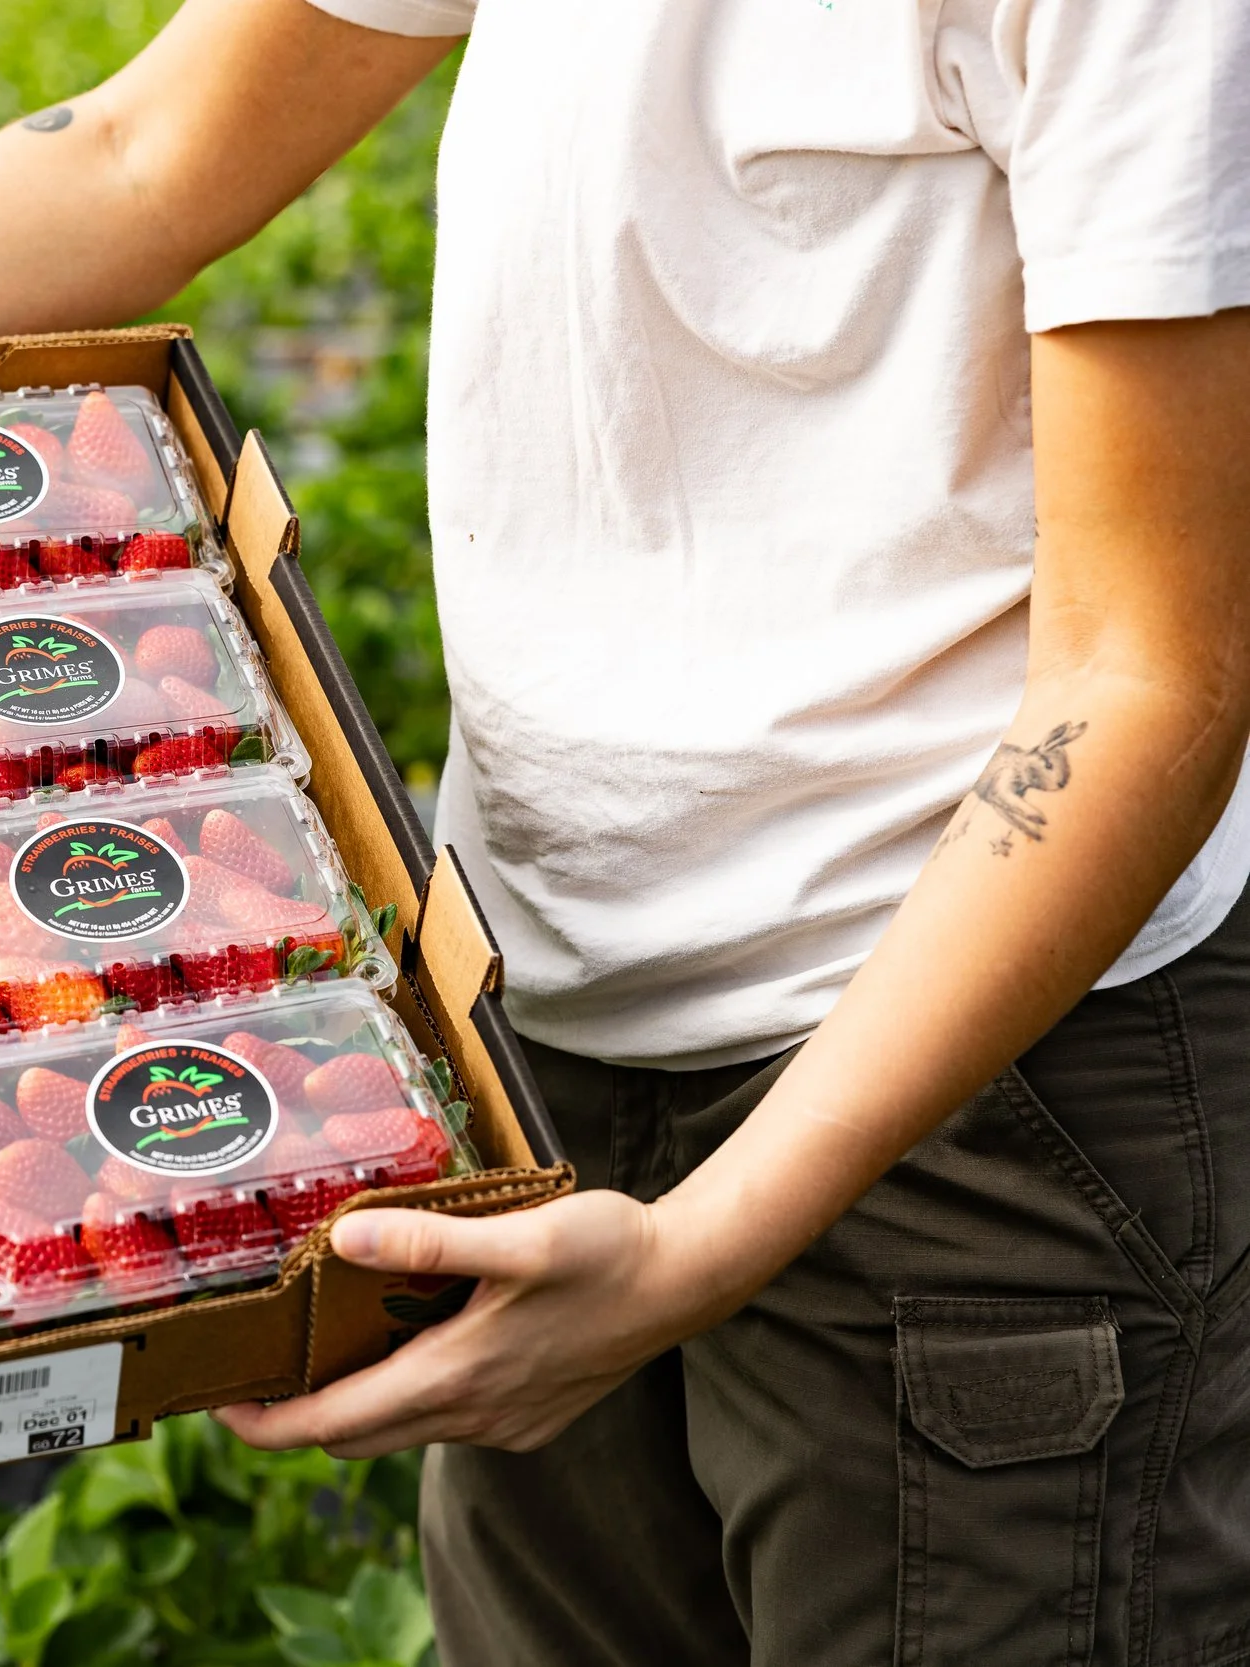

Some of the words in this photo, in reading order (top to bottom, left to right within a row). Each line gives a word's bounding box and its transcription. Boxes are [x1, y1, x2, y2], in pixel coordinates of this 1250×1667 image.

[50, 623, 97, 648] FRAISES
[69, 674, 93, 682] farms
[21, 825, 97, 873] STRAWBERRIES
[109, 827, 160, 855] FRAISES
[50, 870, 155, 897] GRIMES
[130, 885, 156, 894] farms
[190, 1048, 245, 1078] FRAISES
[129, 1094, 241, 1128] GRIMES
[23, 1416, 60, 1431] Dec
[66, 1409, 87, 1423] 01
[51, 1427, 82, 1448] 72
